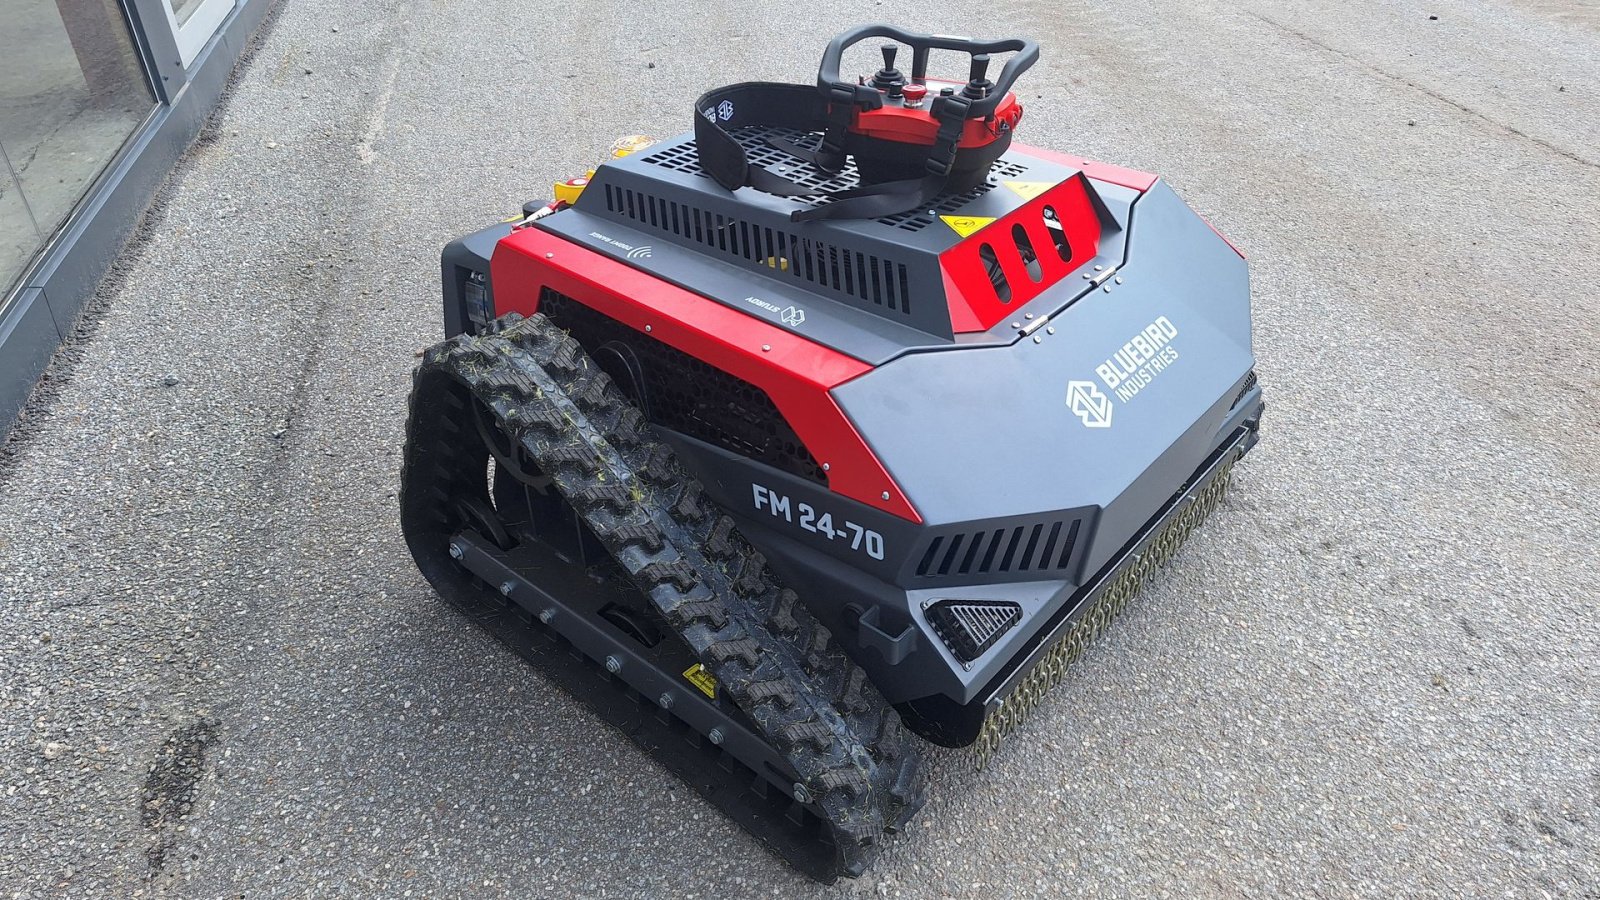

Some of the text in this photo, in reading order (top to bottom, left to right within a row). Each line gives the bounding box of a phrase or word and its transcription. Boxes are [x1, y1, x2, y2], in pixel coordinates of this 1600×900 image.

[744, 296, 780, 313] STURDY
[1095, 315, 1178, 390] BLUEBIRD
[1114, 345, 1179, 404] INDUSTRIES
[752, 483, 885, 561] FM 24-70
